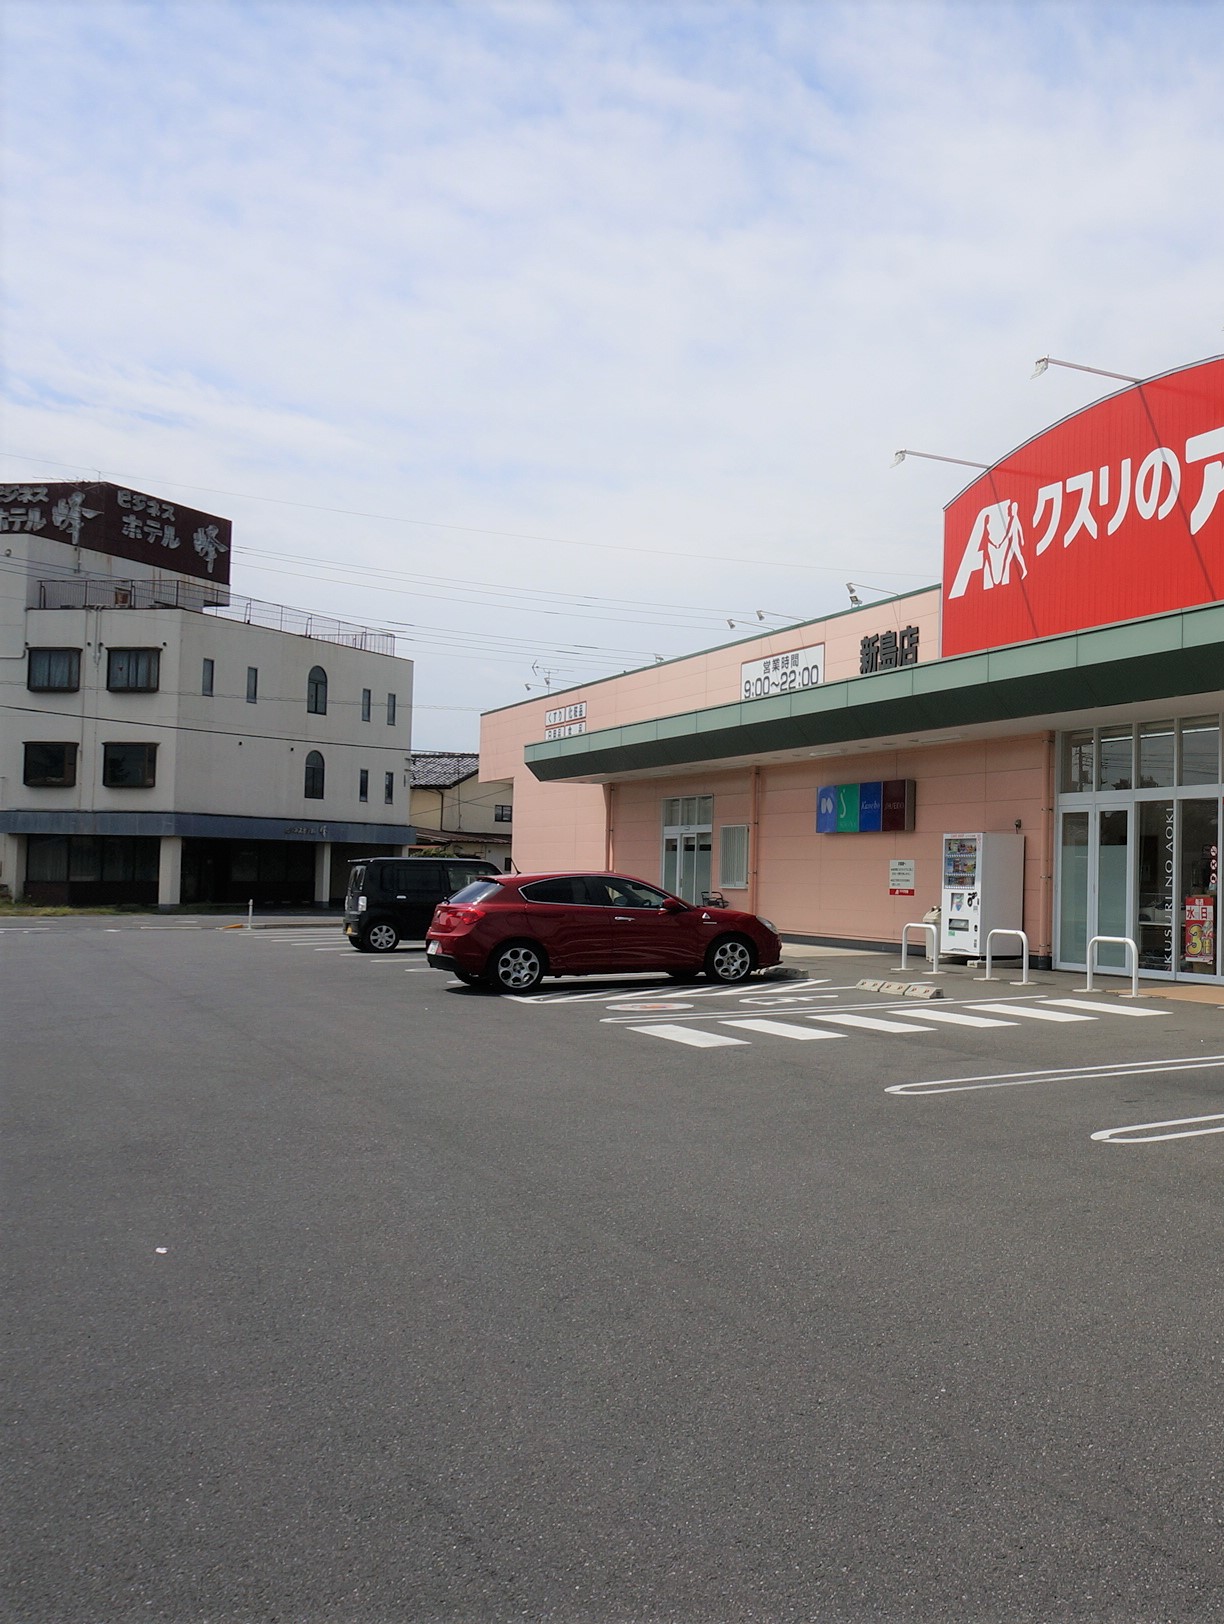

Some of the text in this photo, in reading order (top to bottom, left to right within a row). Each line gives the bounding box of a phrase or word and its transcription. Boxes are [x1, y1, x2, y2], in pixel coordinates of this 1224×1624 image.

[0, 485, 49, 503] ジネス
[117, 489, 176, 522] ビジネス
[121, 513, 181, 549] ホテル
[763, 653, 800, 675] 営業時間
[859, 625, 920, 675] 新島店
